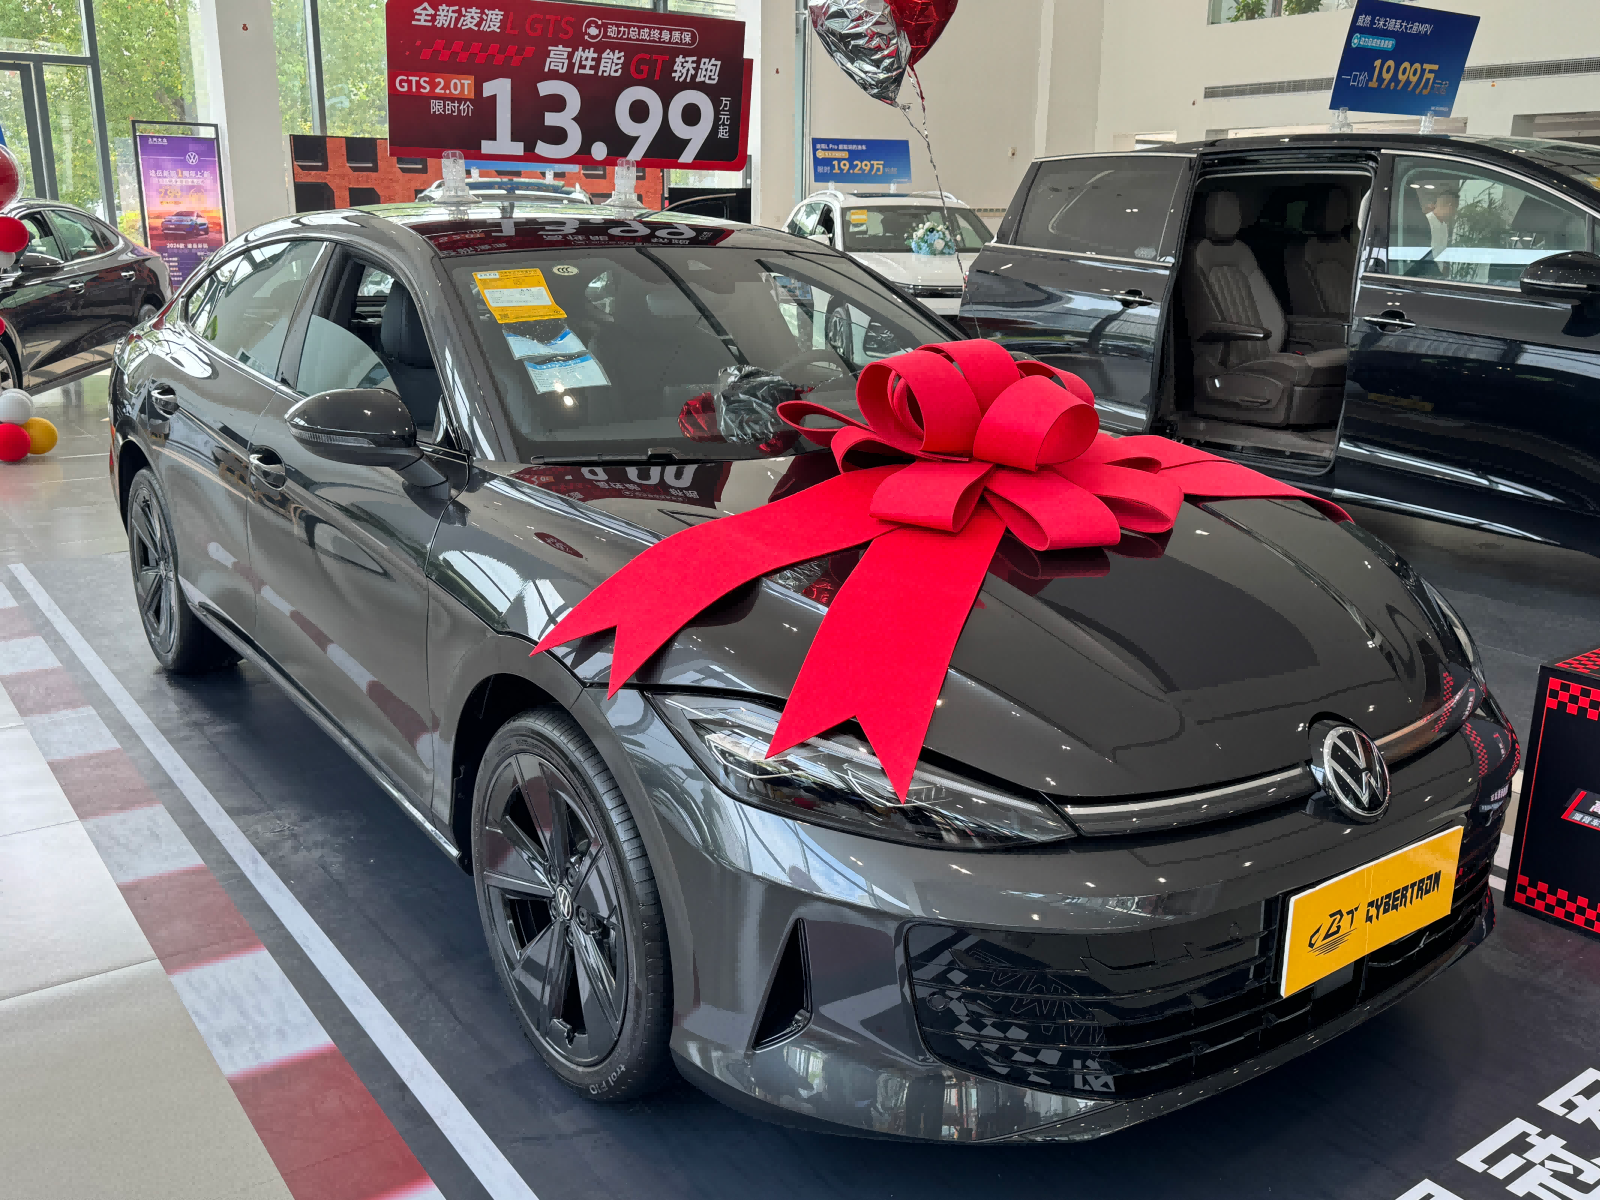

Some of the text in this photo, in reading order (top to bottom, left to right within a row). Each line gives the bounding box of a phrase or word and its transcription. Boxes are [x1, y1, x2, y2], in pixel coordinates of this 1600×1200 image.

[411, 2, 575, 39] 全新凌渡 L GTS
[606, 25, 692, 44] 动力总成终身质保
[544, 46, 722, 85] 高性能 GT 轿跑
[1368, 59, 1439, 95] 19.99万
[395, 76, 471, 95] GTS 2.0T
[430, 100, 474, 117] 限时价
[480, 77, 715, 164] 13.99
[717, 97, 731, 139] 万元起
[832, 161, 884, 175] 19.29万
[1364, 869, 1442, 924] CYBERTRON
